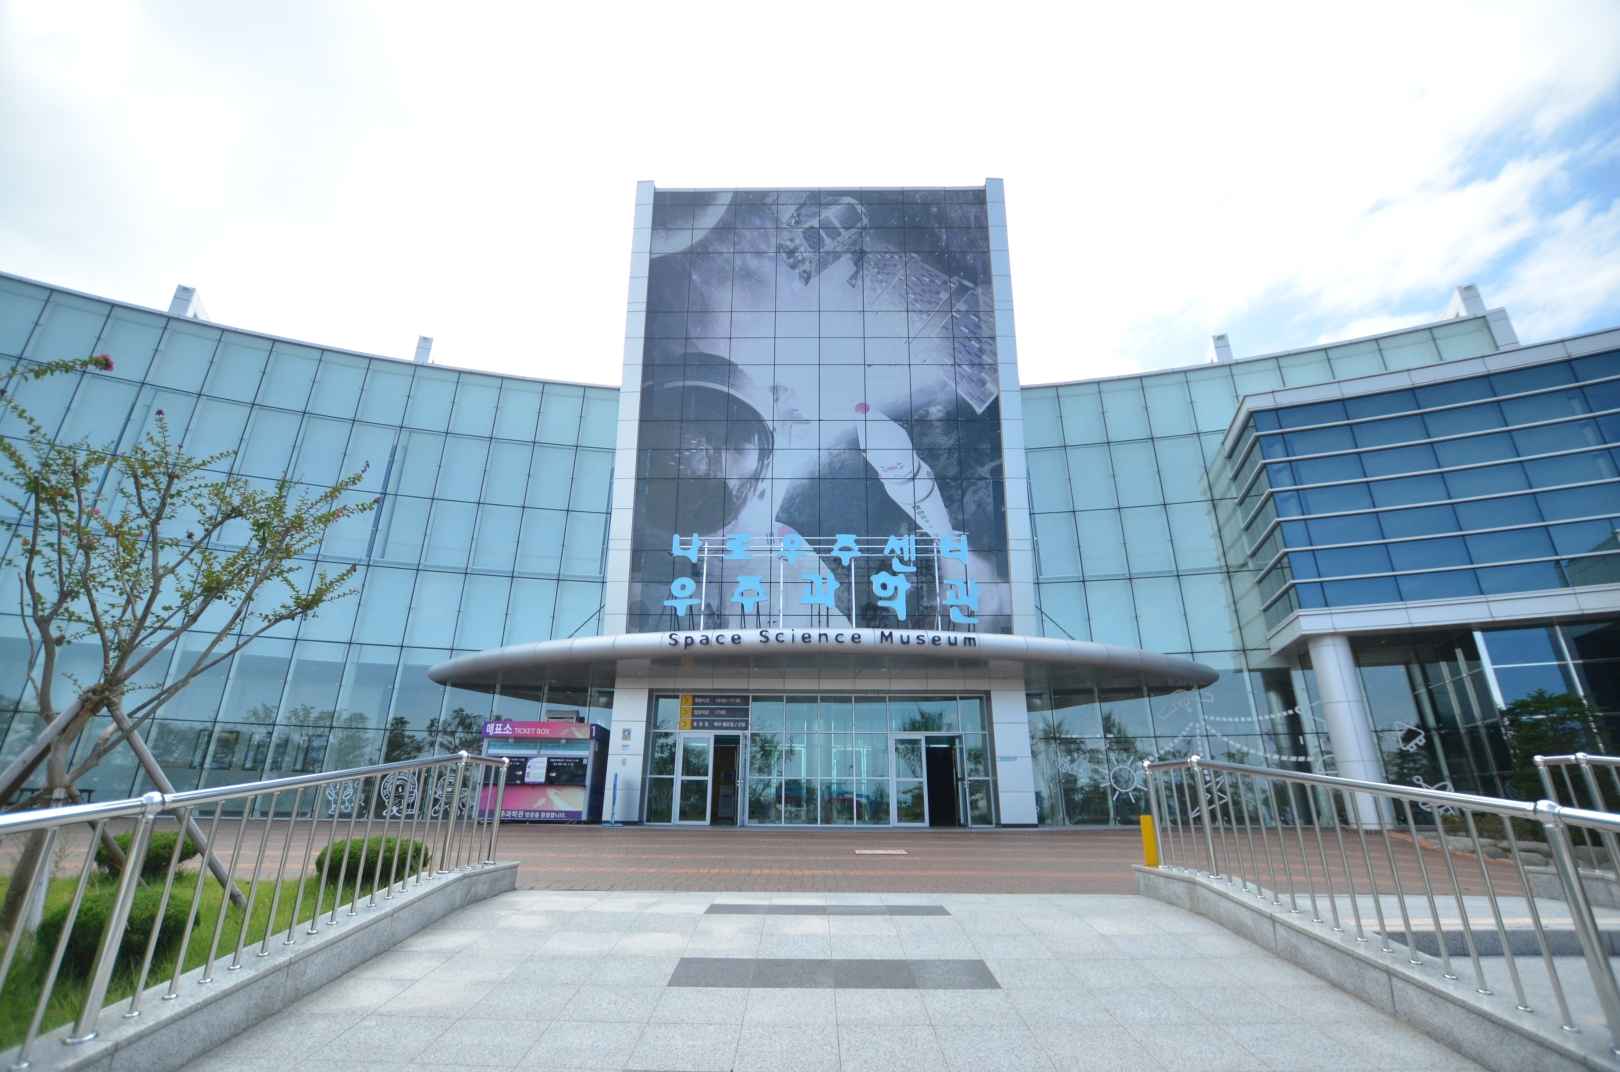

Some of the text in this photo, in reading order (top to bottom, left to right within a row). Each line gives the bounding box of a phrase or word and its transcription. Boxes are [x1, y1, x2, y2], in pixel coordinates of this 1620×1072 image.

[672, 533, 969, 572] 나로우주센터
[663, 571, 980, 624] 우주과학관
[668, 629, 977, 650] Space Science Museum
[486, 723, 512, 736] 매표소
